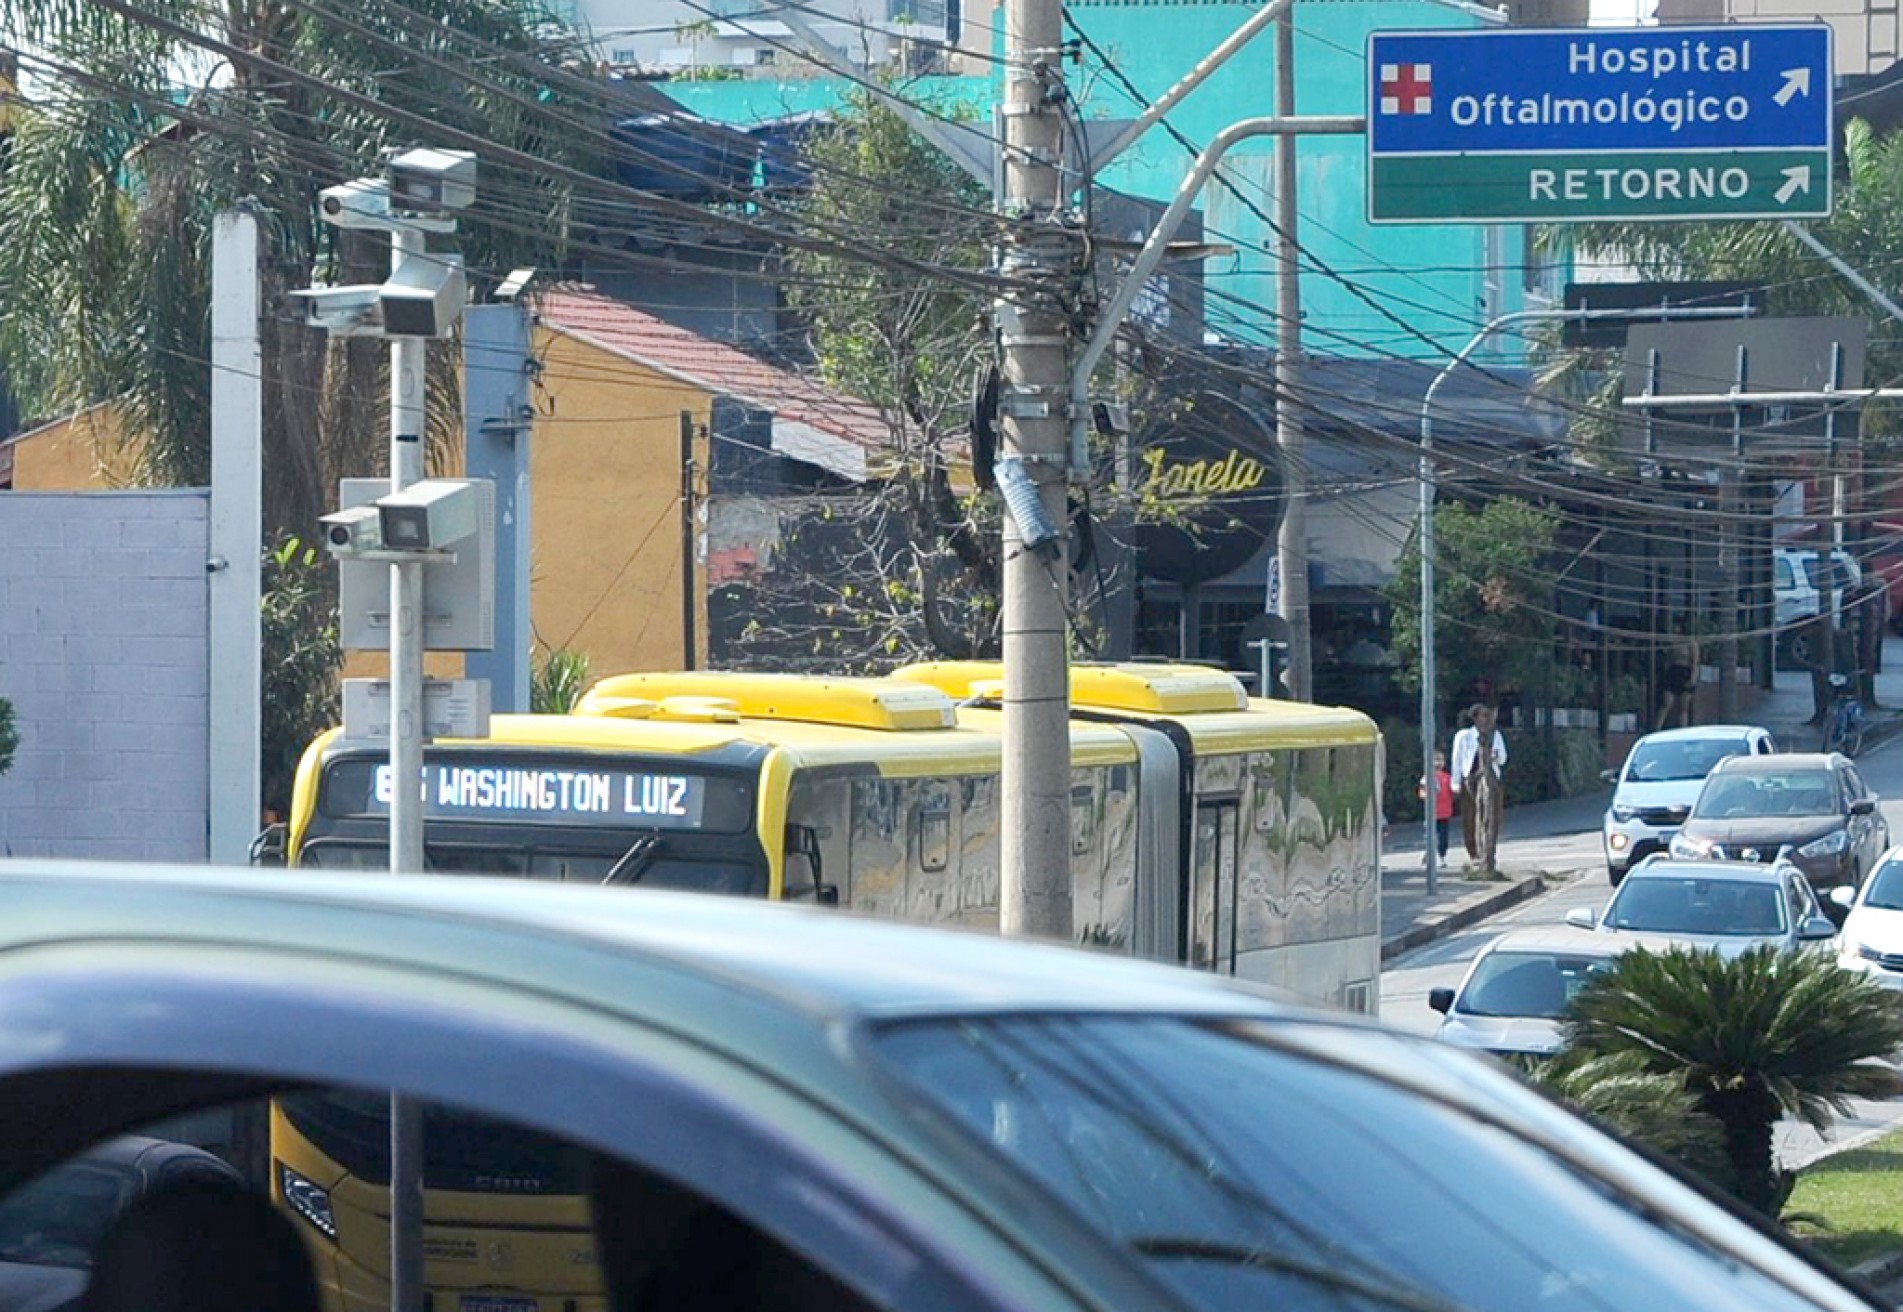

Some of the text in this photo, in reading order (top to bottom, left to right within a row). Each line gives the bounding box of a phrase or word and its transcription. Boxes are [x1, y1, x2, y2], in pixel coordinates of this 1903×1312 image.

[1568, 39, 1751, 78] Hospital
[1450, 88, 1749, 131] Oftalmológico
[1529, 167, 1750, 202] RETORNO
[439, 767, 610, 812] WASHINGTON
[624, 776, 687, 815] LUIZ
